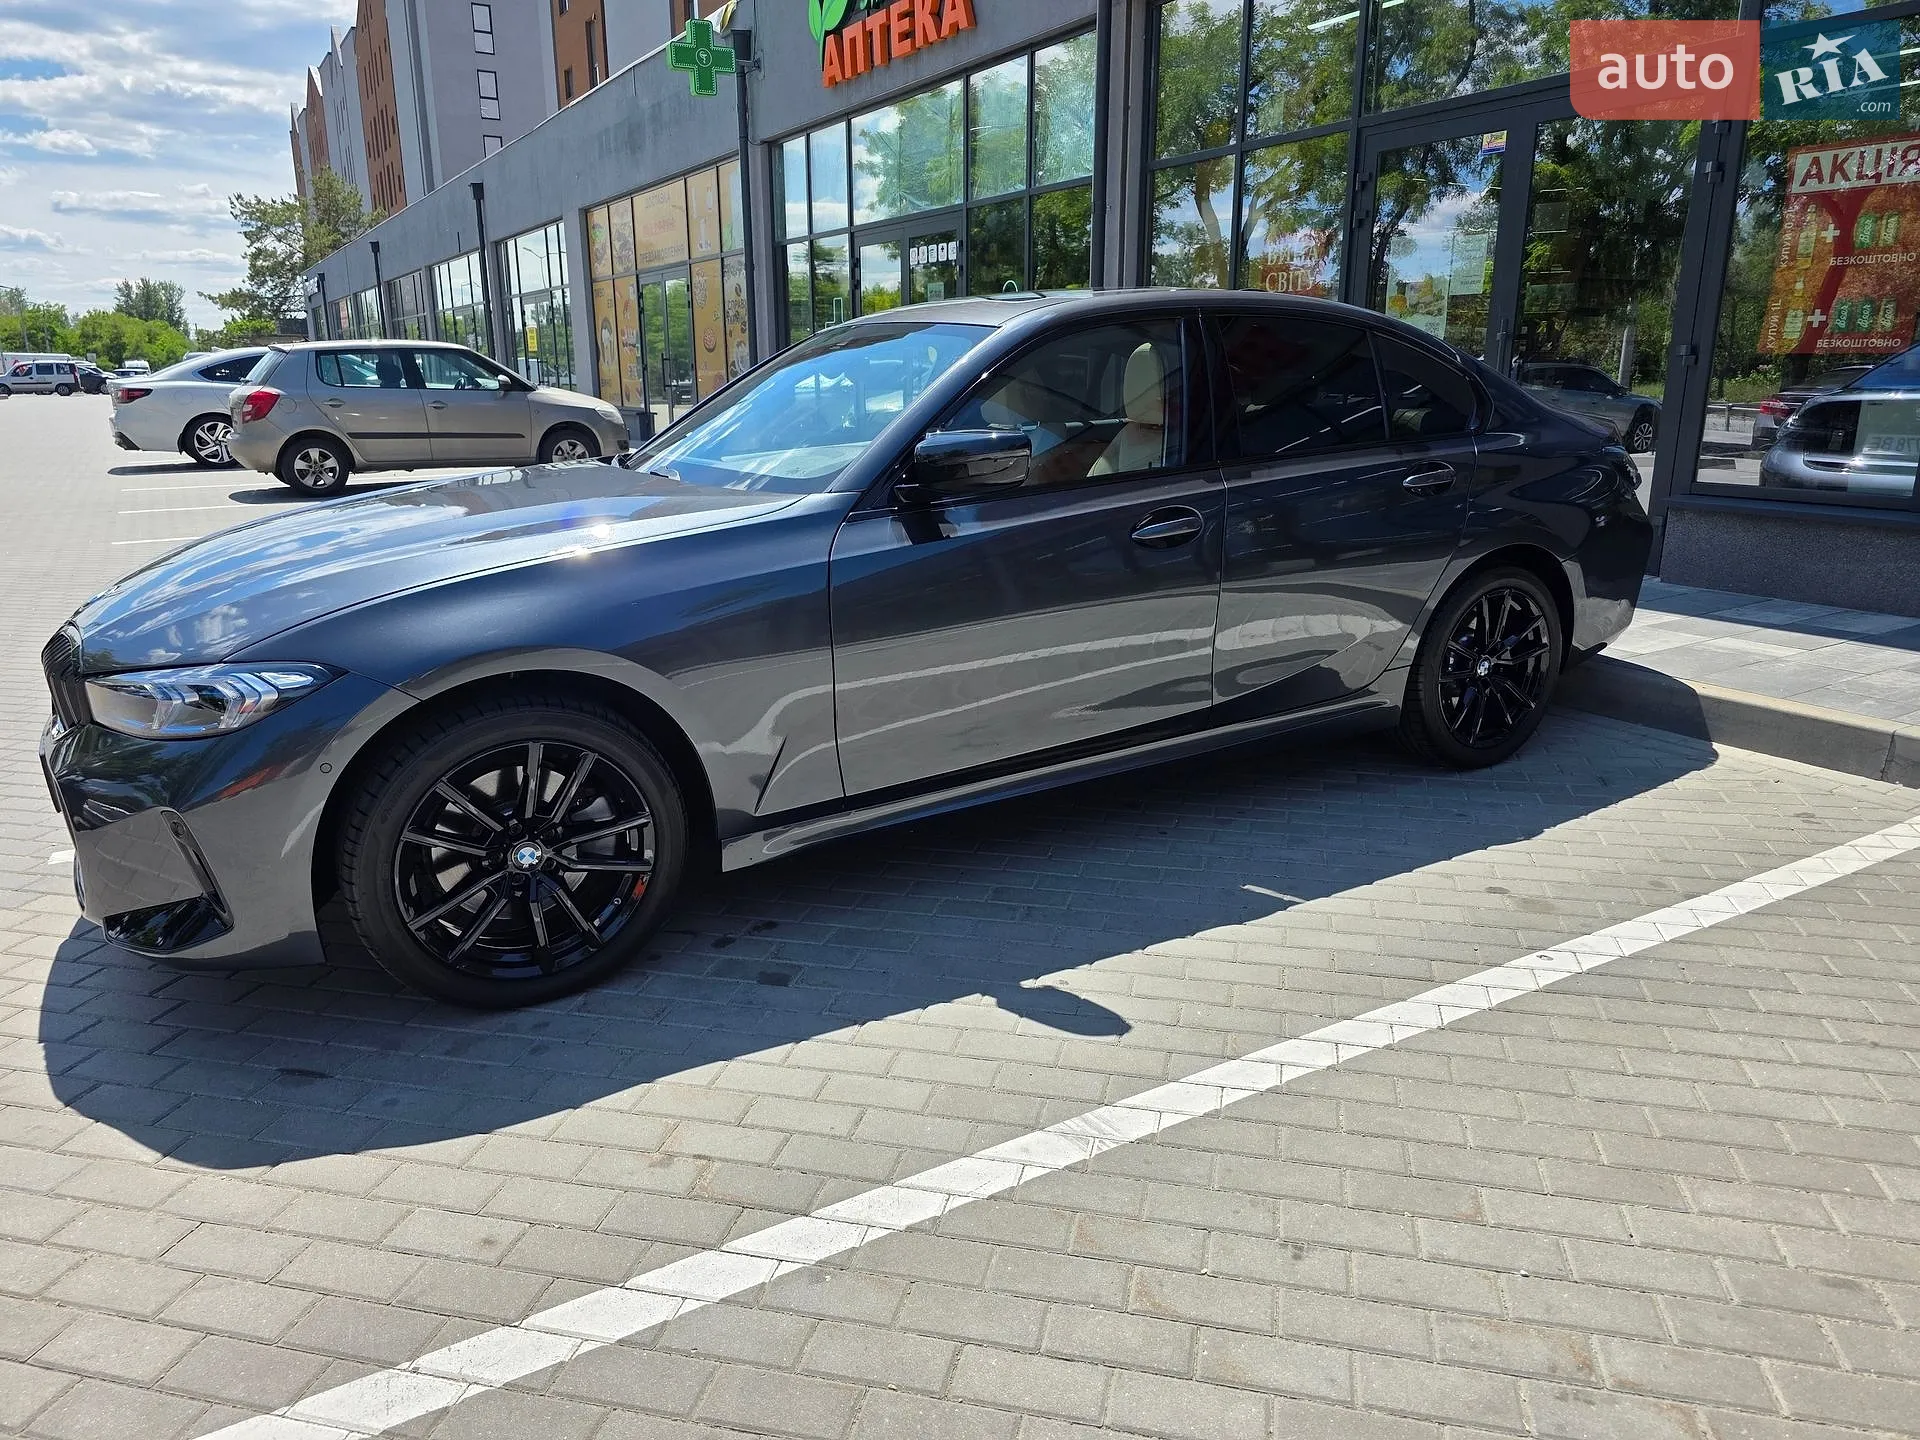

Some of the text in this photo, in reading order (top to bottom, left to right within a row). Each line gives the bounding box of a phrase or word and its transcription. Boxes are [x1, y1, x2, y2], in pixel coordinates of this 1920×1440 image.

[823, 0, 977, 88] АПТЕКА
[1799, 143, 1920, 187] АКЦІЯ
[1830, 252, 1917, 266] БЕЗКОШТОВНО
[1265, 269, 1315, 293] СВІТУ
[1766, 315, 1780, 349] КУПУЙ
[1816, 338, 1901, 348] БЕЗКОШТОВНО
